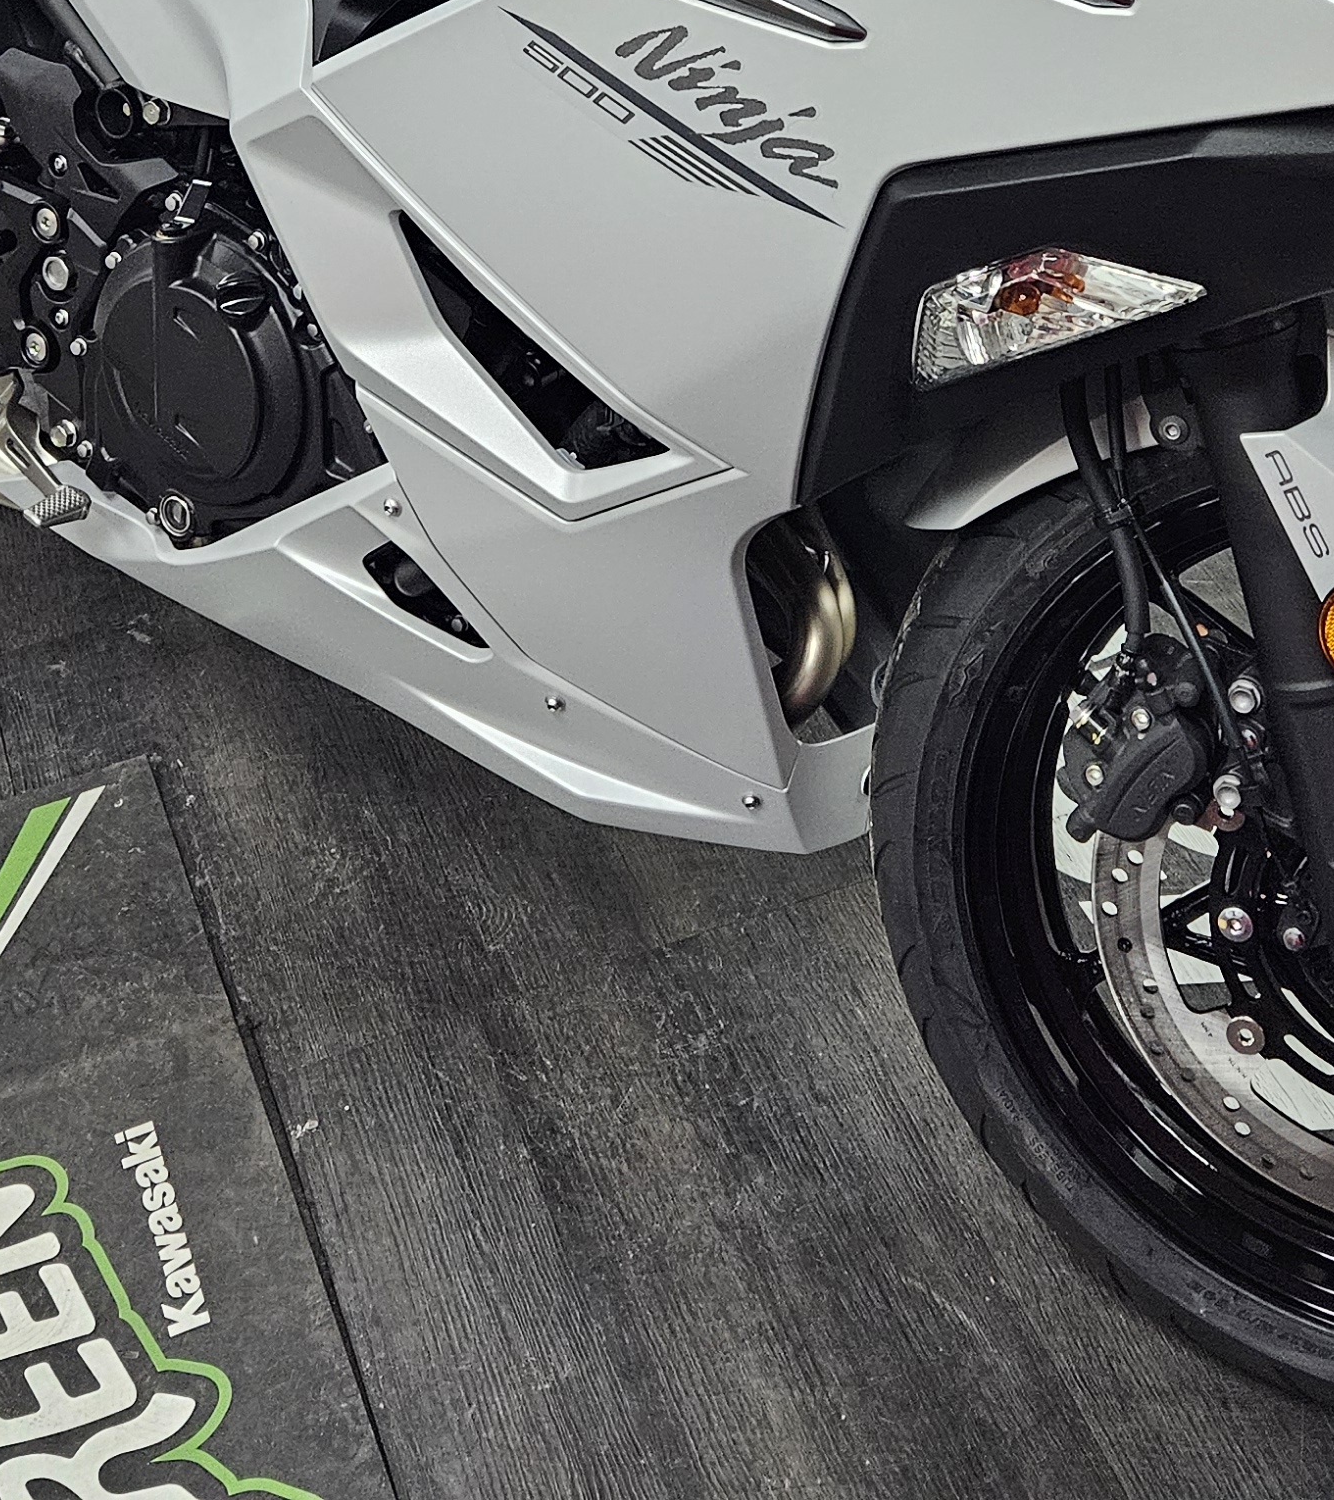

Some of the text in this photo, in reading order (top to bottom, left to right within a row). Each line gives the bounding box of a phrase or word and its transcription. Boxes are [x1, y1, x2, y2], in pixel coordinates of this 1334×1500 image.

[522, 40, 636, 125] 500
[614, 24, 840, 190] Ninja
[1264, 449, 1330, 559] ABS
[114, 1120, 212, 1339] Kawasaki
